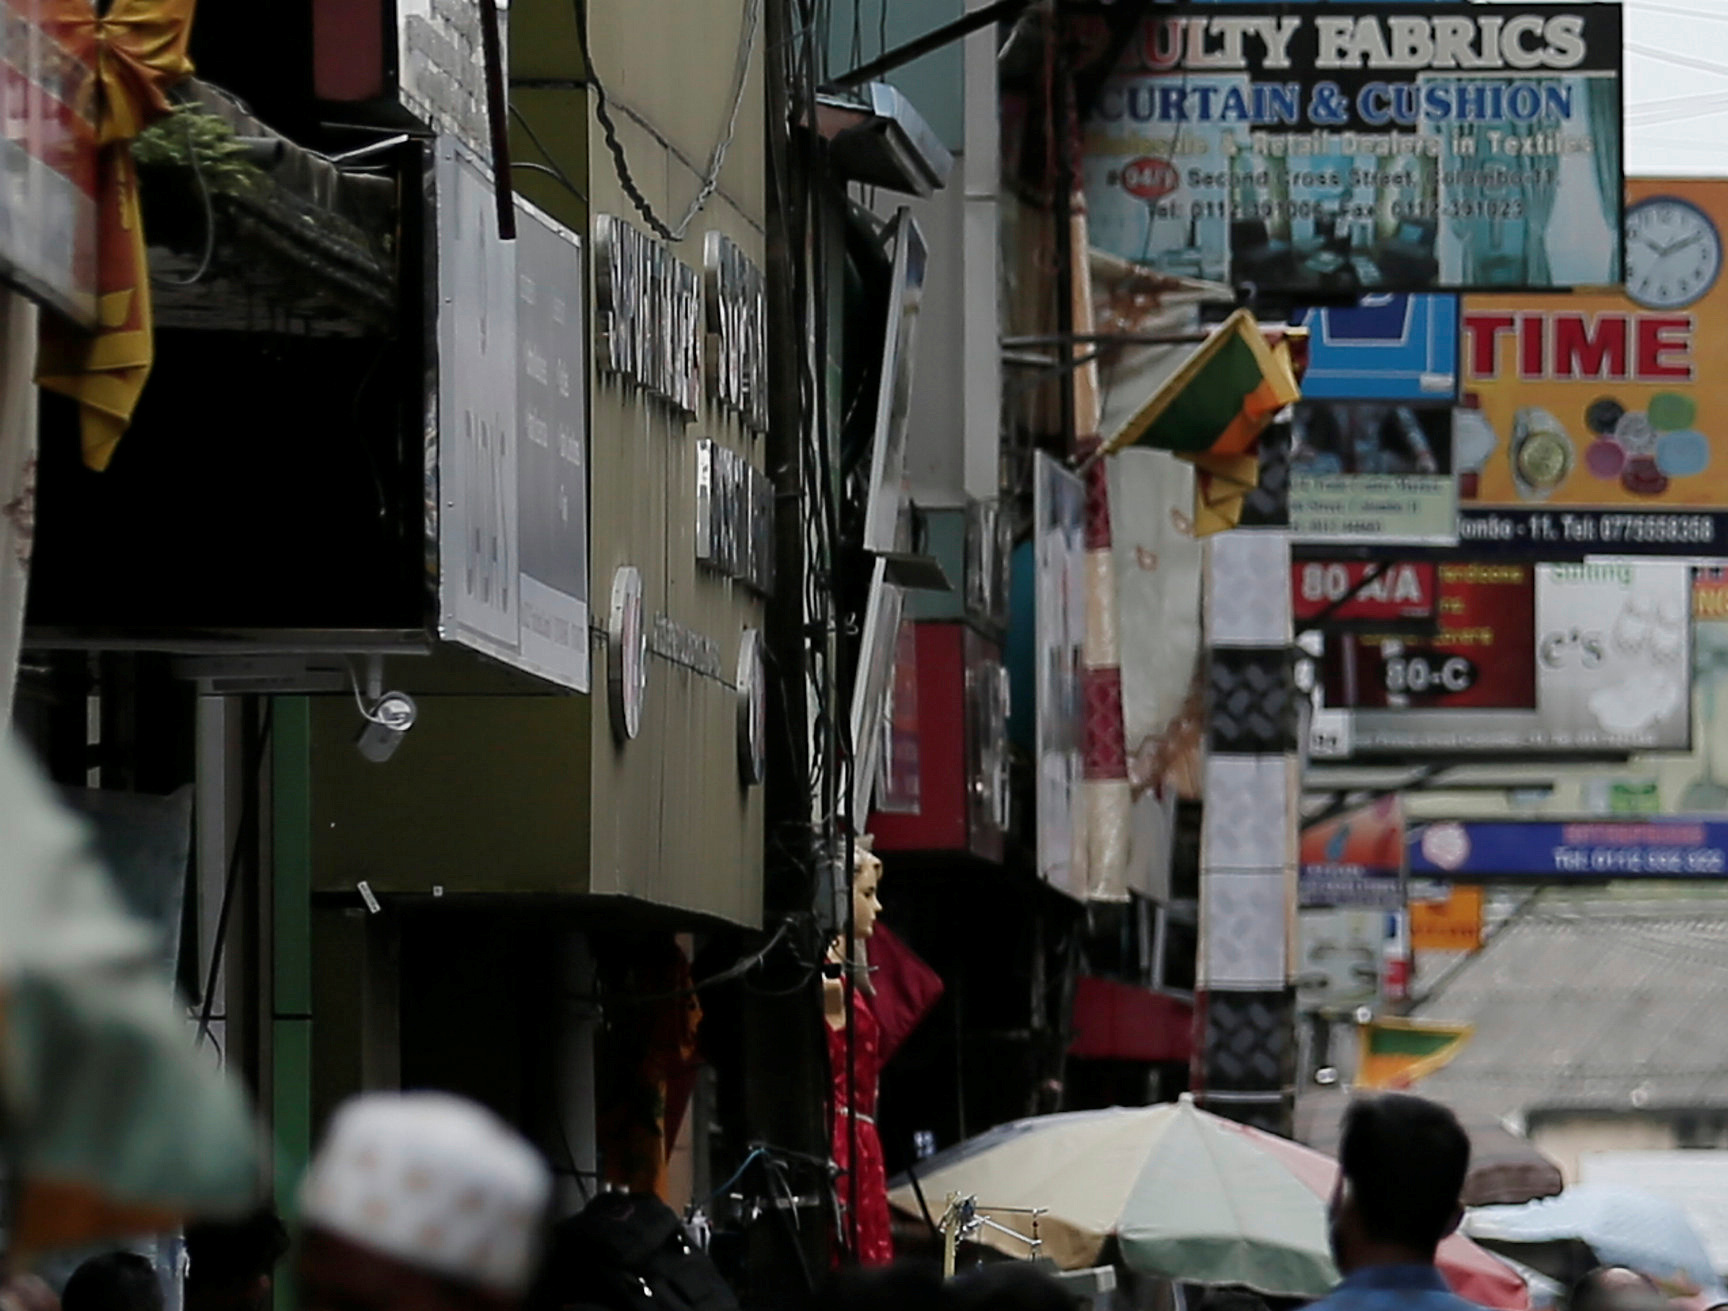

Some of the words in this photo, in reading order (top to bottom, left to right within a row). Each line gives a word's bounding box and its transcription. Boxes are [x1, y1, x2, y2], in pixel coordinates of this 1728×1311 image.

[1315, 14, 1586, 69] FABRICS
[1099, 81, 1300, 124] CURTAIN
[1309, 80, 1349, 124] &
[1357, 81, 1572, 125] CUSHION
[1253, 129, 1331, 156] Retail
[1454, 130, 1476, 156] in
[1461, 311, 1694, 381] TIME
[1302, 562, 1348, 602] 80
